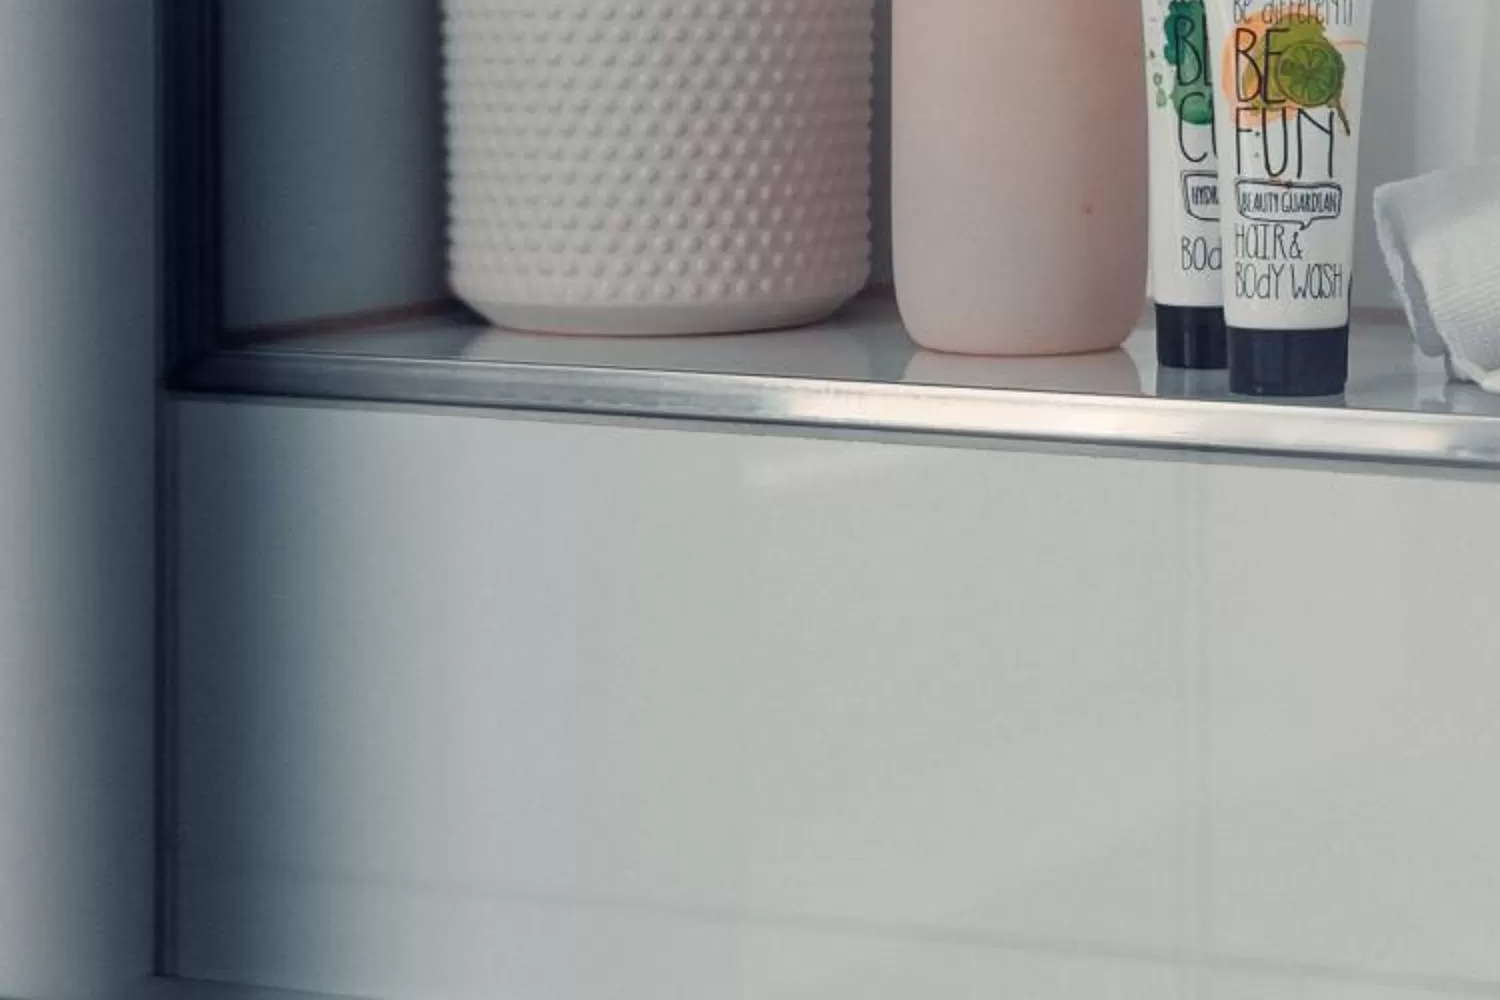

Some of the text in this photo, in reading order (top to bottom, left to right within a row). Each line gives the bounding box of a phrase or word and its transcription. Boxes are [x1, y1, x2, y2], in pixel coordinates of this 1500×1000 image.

[1233, 26, 1291, 106] BE
[1235, 107, 1335, 180] FUN
[1241, 191, 1337, 215] BEAUTY GUARDIAN
[1288, 231, 1303, 261] &
